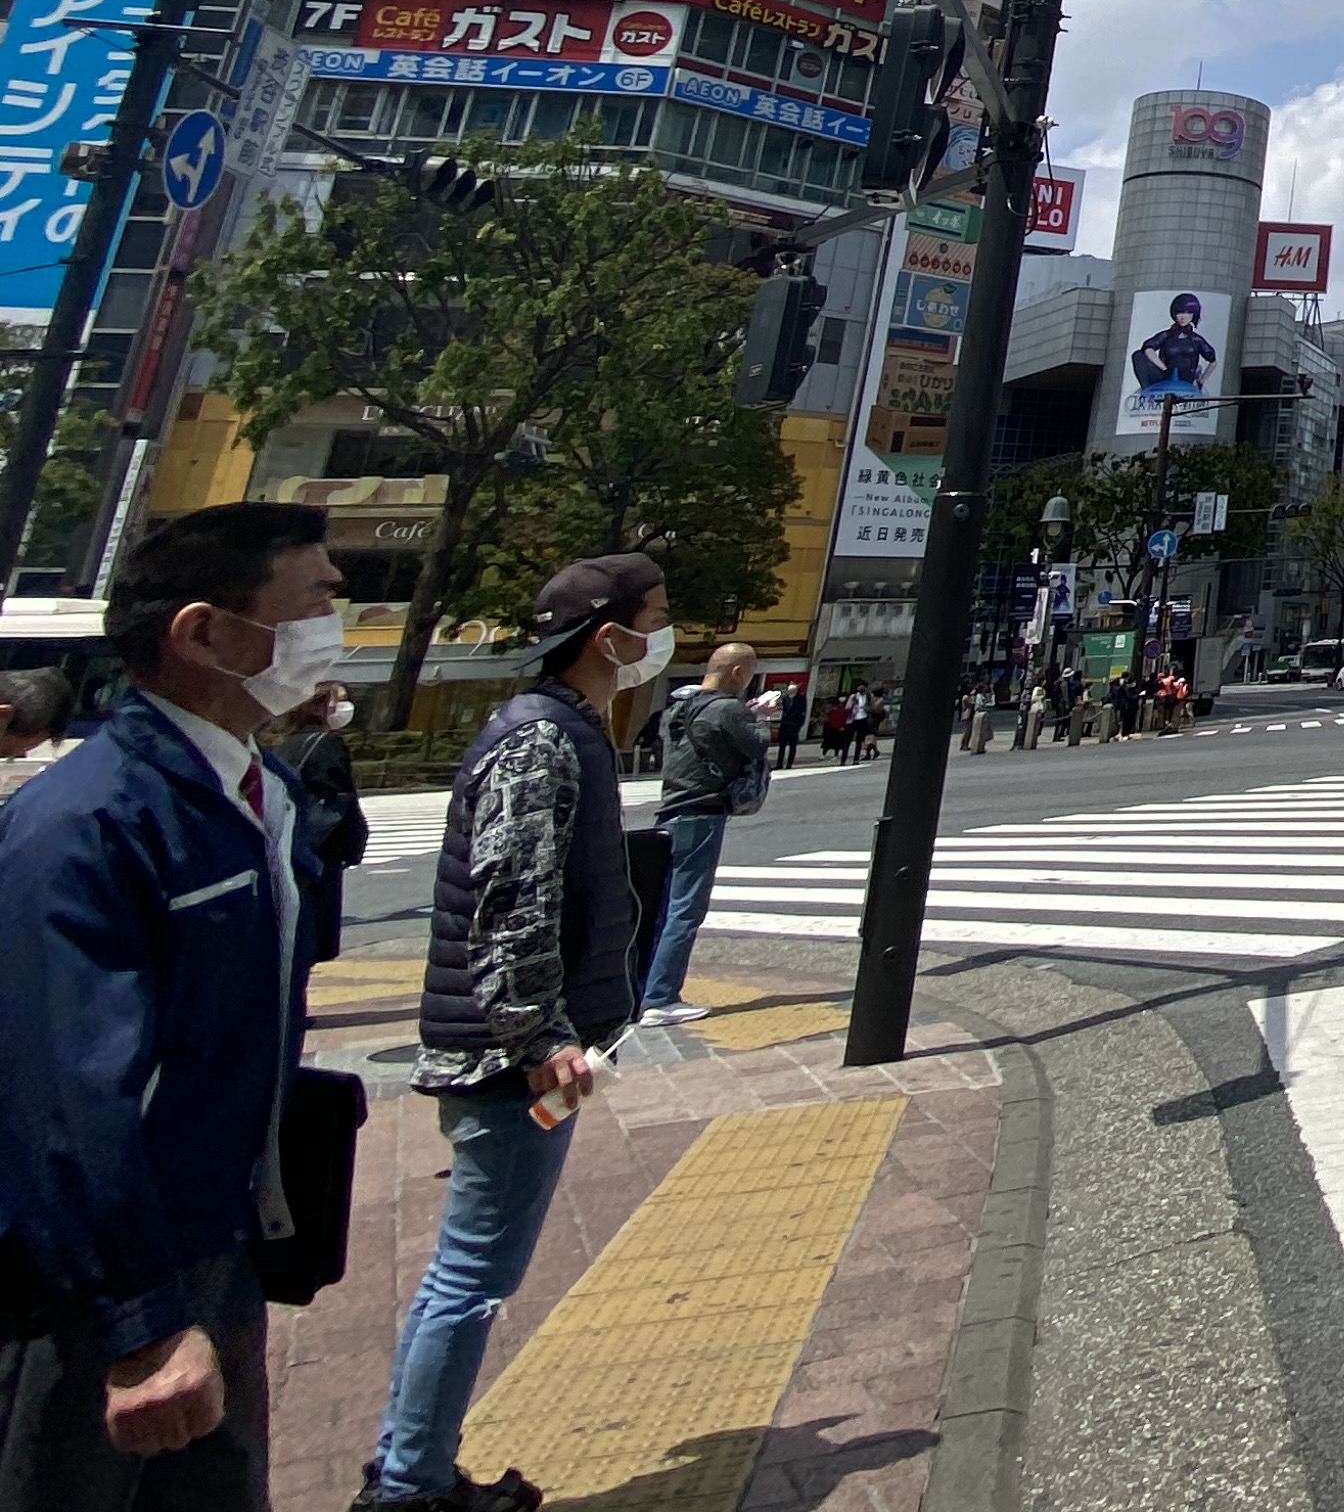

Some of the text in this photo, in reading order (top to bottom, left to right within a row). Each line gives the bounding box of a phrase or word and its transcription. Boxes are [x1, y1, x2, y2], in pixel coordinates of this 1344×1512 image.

[304, 2, 363, 30] 7F
[375, 5, 441, 30] Café
[442, 5, 592, 54] ガスト
[620, 31, 667, 48] ガスト
[300, 50, 366, 74] EON
[387, 53, 606, 86] 英会話イーオン
[619, 70, 652, 88] 6F
[754, 95, 871, 138] 英会話イー
[1169, 105, 1246, 160] 109
[1168, 145, 1215, 159] SHIBUYA
[1033, 185, 1063, 207] NI
[1273, 245, 1311, 269] H&M
[857, 468, 941, 488] 緑黄色社会
[375, 519, 432, 541] Café
[856, 525, 925, 543] 近日発売
